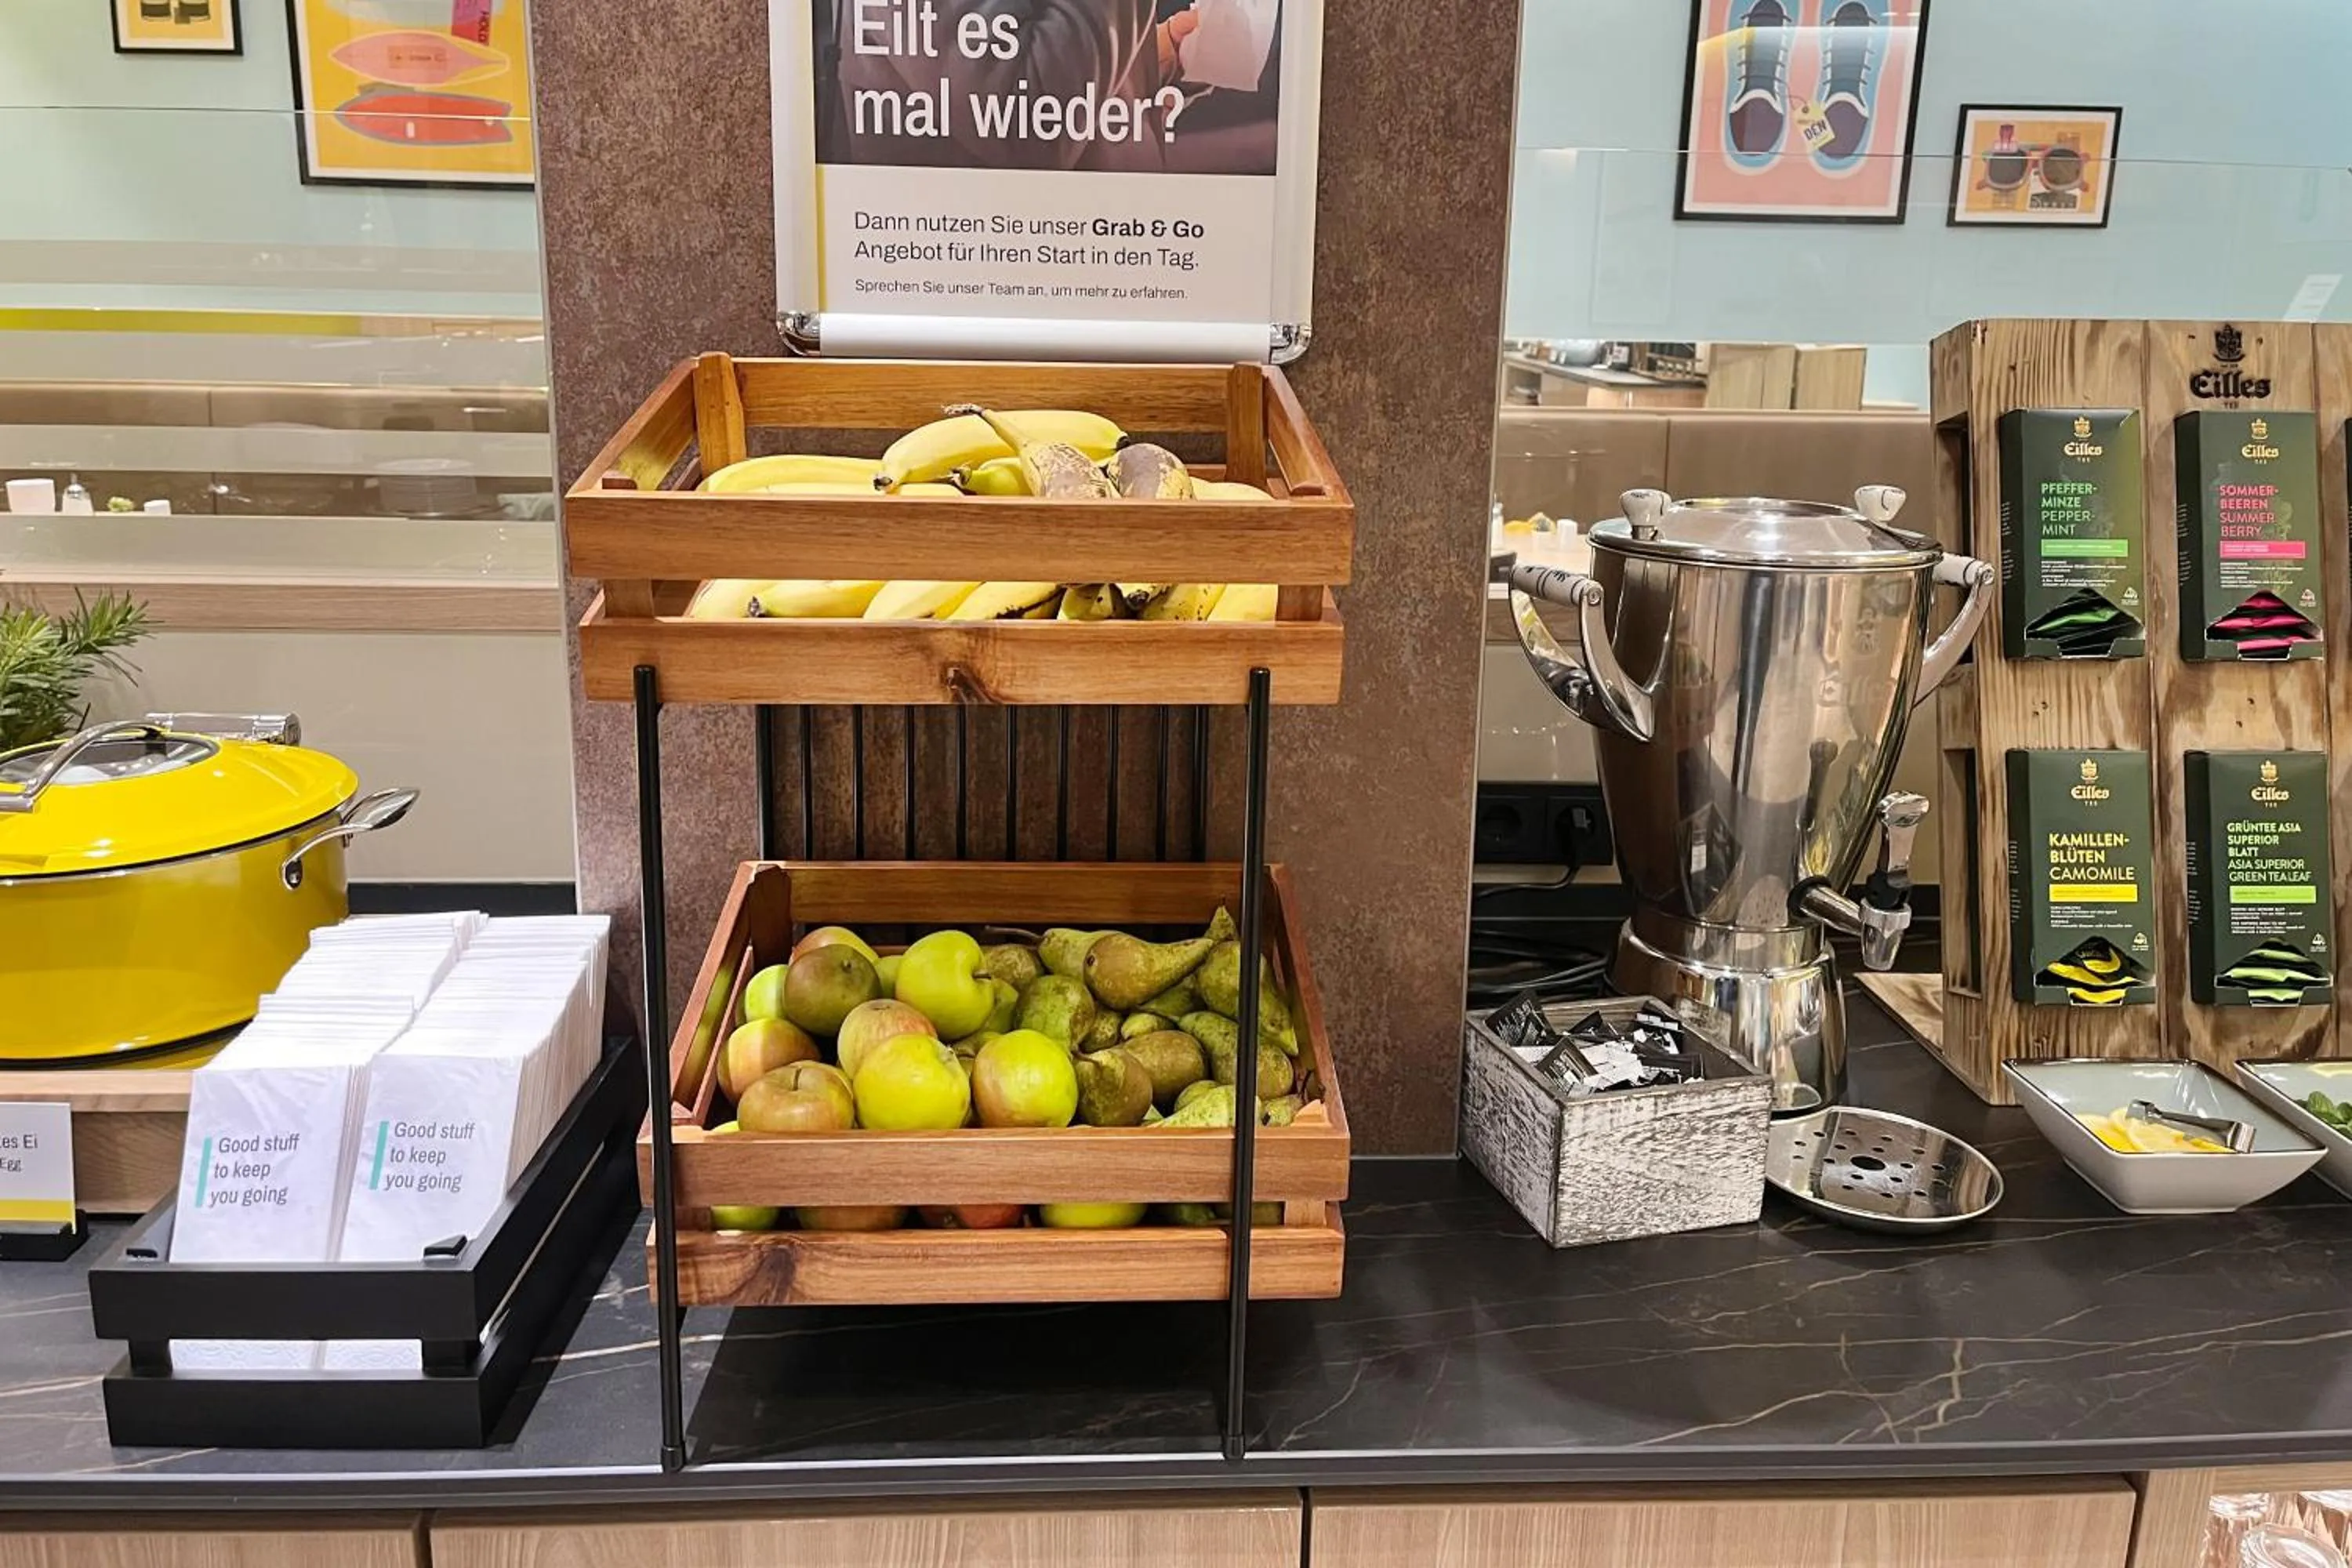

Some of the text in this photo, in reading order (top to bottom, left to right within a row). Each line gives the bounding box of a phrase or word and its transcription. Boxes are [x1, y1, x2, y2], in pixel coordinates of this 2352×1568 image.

[854, 0, 1020, 60] Eilt es
[854, 77, 1185, 143] mal wieder?
[855, 212, 1205, 238] Dann nutzen Sie unser Grab & Go
[854, 240, 1200, 270] Angebot für Ihren Start in den Tag.
[855, 278, 920, 294] Sprechen
[923, 281, 945, 294] Sie
[948, 284, 985, 294] unser
[989, 282, 1025, 296] Team
[1051, 286, 1073, 296] um
[1075, 285, 1109, 297] mehr
[1112, 287, 1127, 298] zu
[1130, 285, 1189, 299] erfahren.
[2190, 368, 2272, 398] Eilles
[2063, 441, 2103, 456] Eilles
[2241, 443, 2280, 458] Eilles
[2040, 482, 2098, 495] PFEFFER-
[2220, 485, 2279, 496] SOMMER-
[2040, 496, 2082, 508] MINZE
[2220, 499, 2269, 510] BEEREN
[2041, 510, 2096, 522] PEPPER-
[2220, 512, 2275, 523] SUMMER
[2042, 524, 2077, 535] MINT
[2220, 525, 2263, 537] BERRY
[2070, 785, 2110, 800] Eilles
[2250, 786, 2290, 801] Eilles
[2227, 819, 2302, 832] GRÜNTEE ASIA
[2049, 833, 2131, 847] KAMILLEN-
[2227, 834, 2280, 845] SUPERIOR
[2049, 847, 2106, 863] BLÜTEN
[2227, 847, 2259, 857] BLATT
[2227, 858, 2305, 869] ASIA SUPERIOR
[2049, 866, 2136, 880] CAMOMILE
[2228, 871, 2267, 882] GREEN
[394, 1121, 476, 1139] Good stuff
[0, 1134, 39, 1149] es Ei
[219, 1132, 300, 1153] Good stuff
[390, 1145, 447, 1167] to keep
[213, 1160, 271, 1181] to keep
[383, 1171, 463, 1193] you going
[209, 1185, 289, 1209] you going
